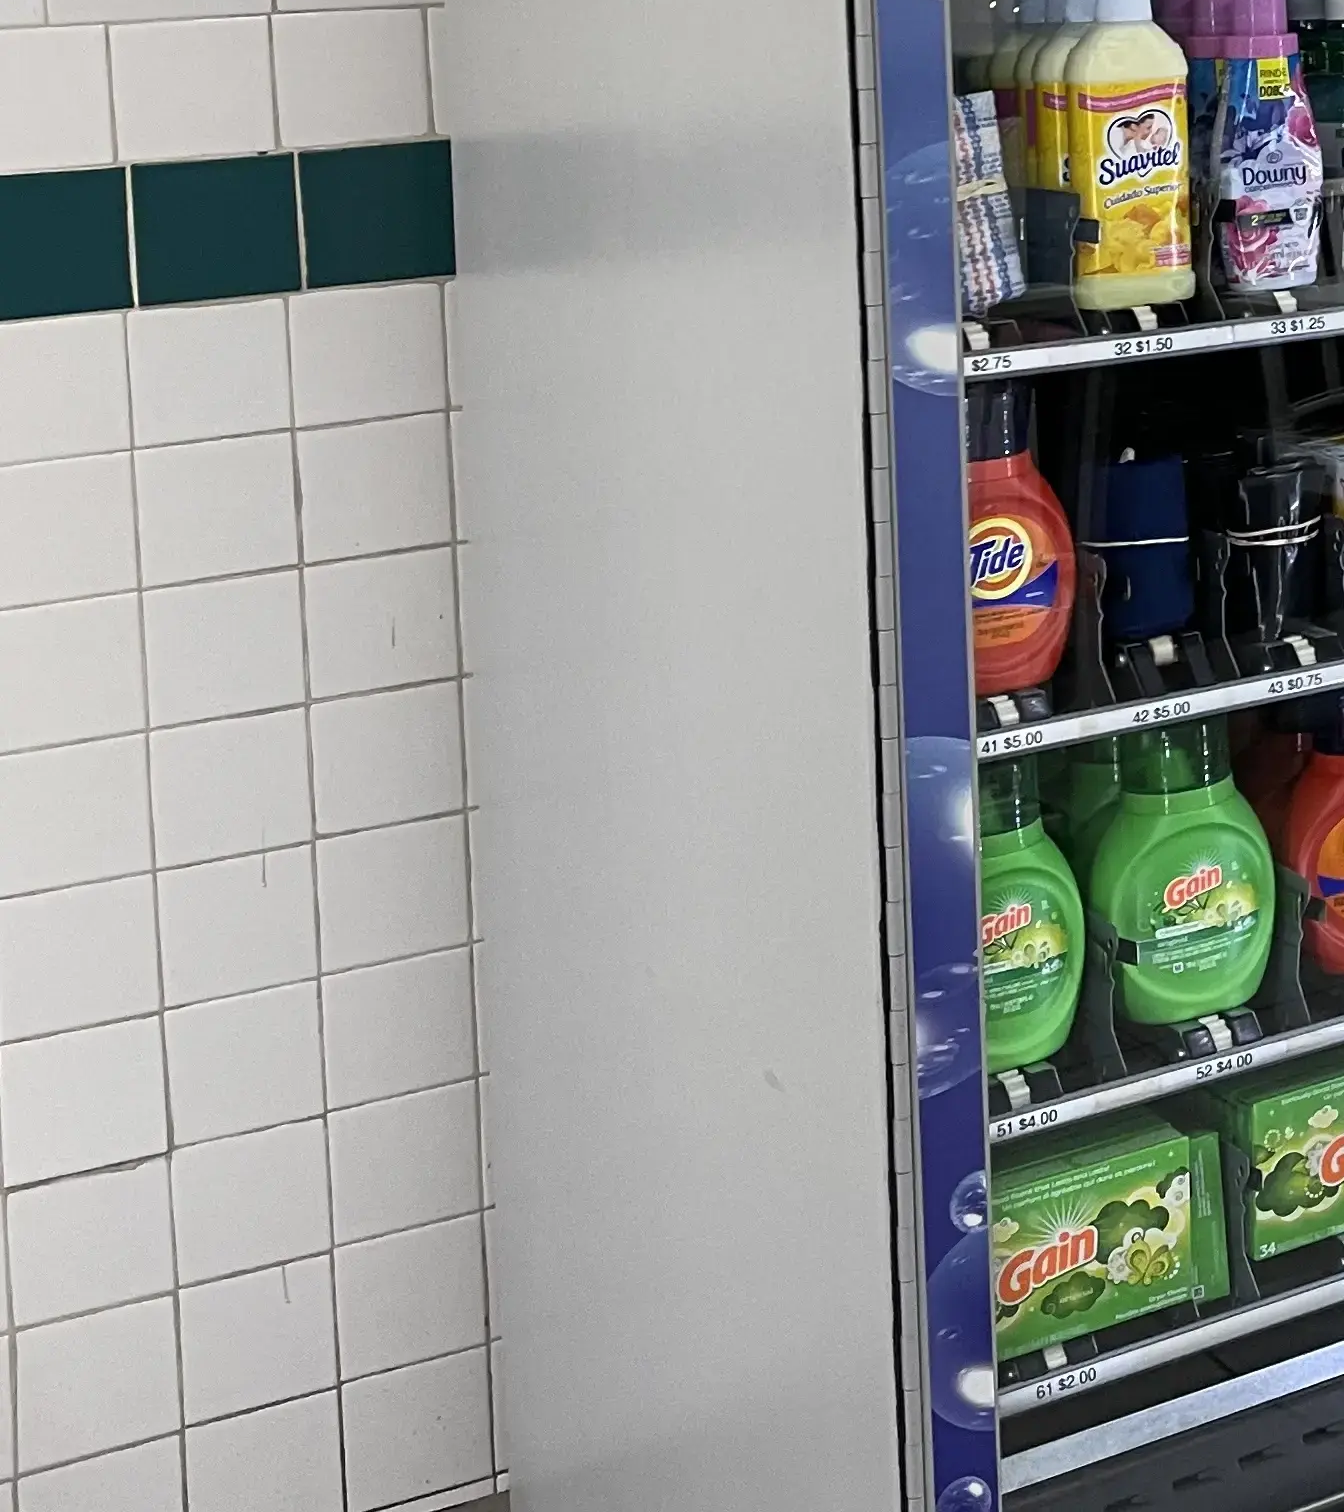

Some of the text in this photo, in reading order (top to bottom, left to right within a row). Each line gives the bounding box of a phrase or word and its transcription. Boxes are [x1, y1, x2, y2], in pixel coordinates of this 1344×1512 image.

[1099, 141, 1181, 186] Suavitel
[1242, 164, 1307, 187] Downy
[1103, 188, 1143, 210] Cuidado
[1270, 316, 1326, 335] 33 $1.25
[1114, 336, 1174, 356] 32 $1.50
[971, 355, 1012, 372] $2.75
[969, 536, 1025, 587] Tide
[1268, 673, 1323, 695] 43 $0.75
[1132, 701, 1191, 724] 42 $5.00
[981, 730, 1043, 754] 41 $5.00
[1164, 866, 1222, 909] Gain
[1196, 1053, 1253, 1081] 52 $4.00
[996, 1109, 1058, 1138] 51 $4.00
[1259, 1241, 1277, 1256] 34
[998, 1227, 1097, 1305] Gain
[1036, 1367, 1098, 1400] 61 $2.00
